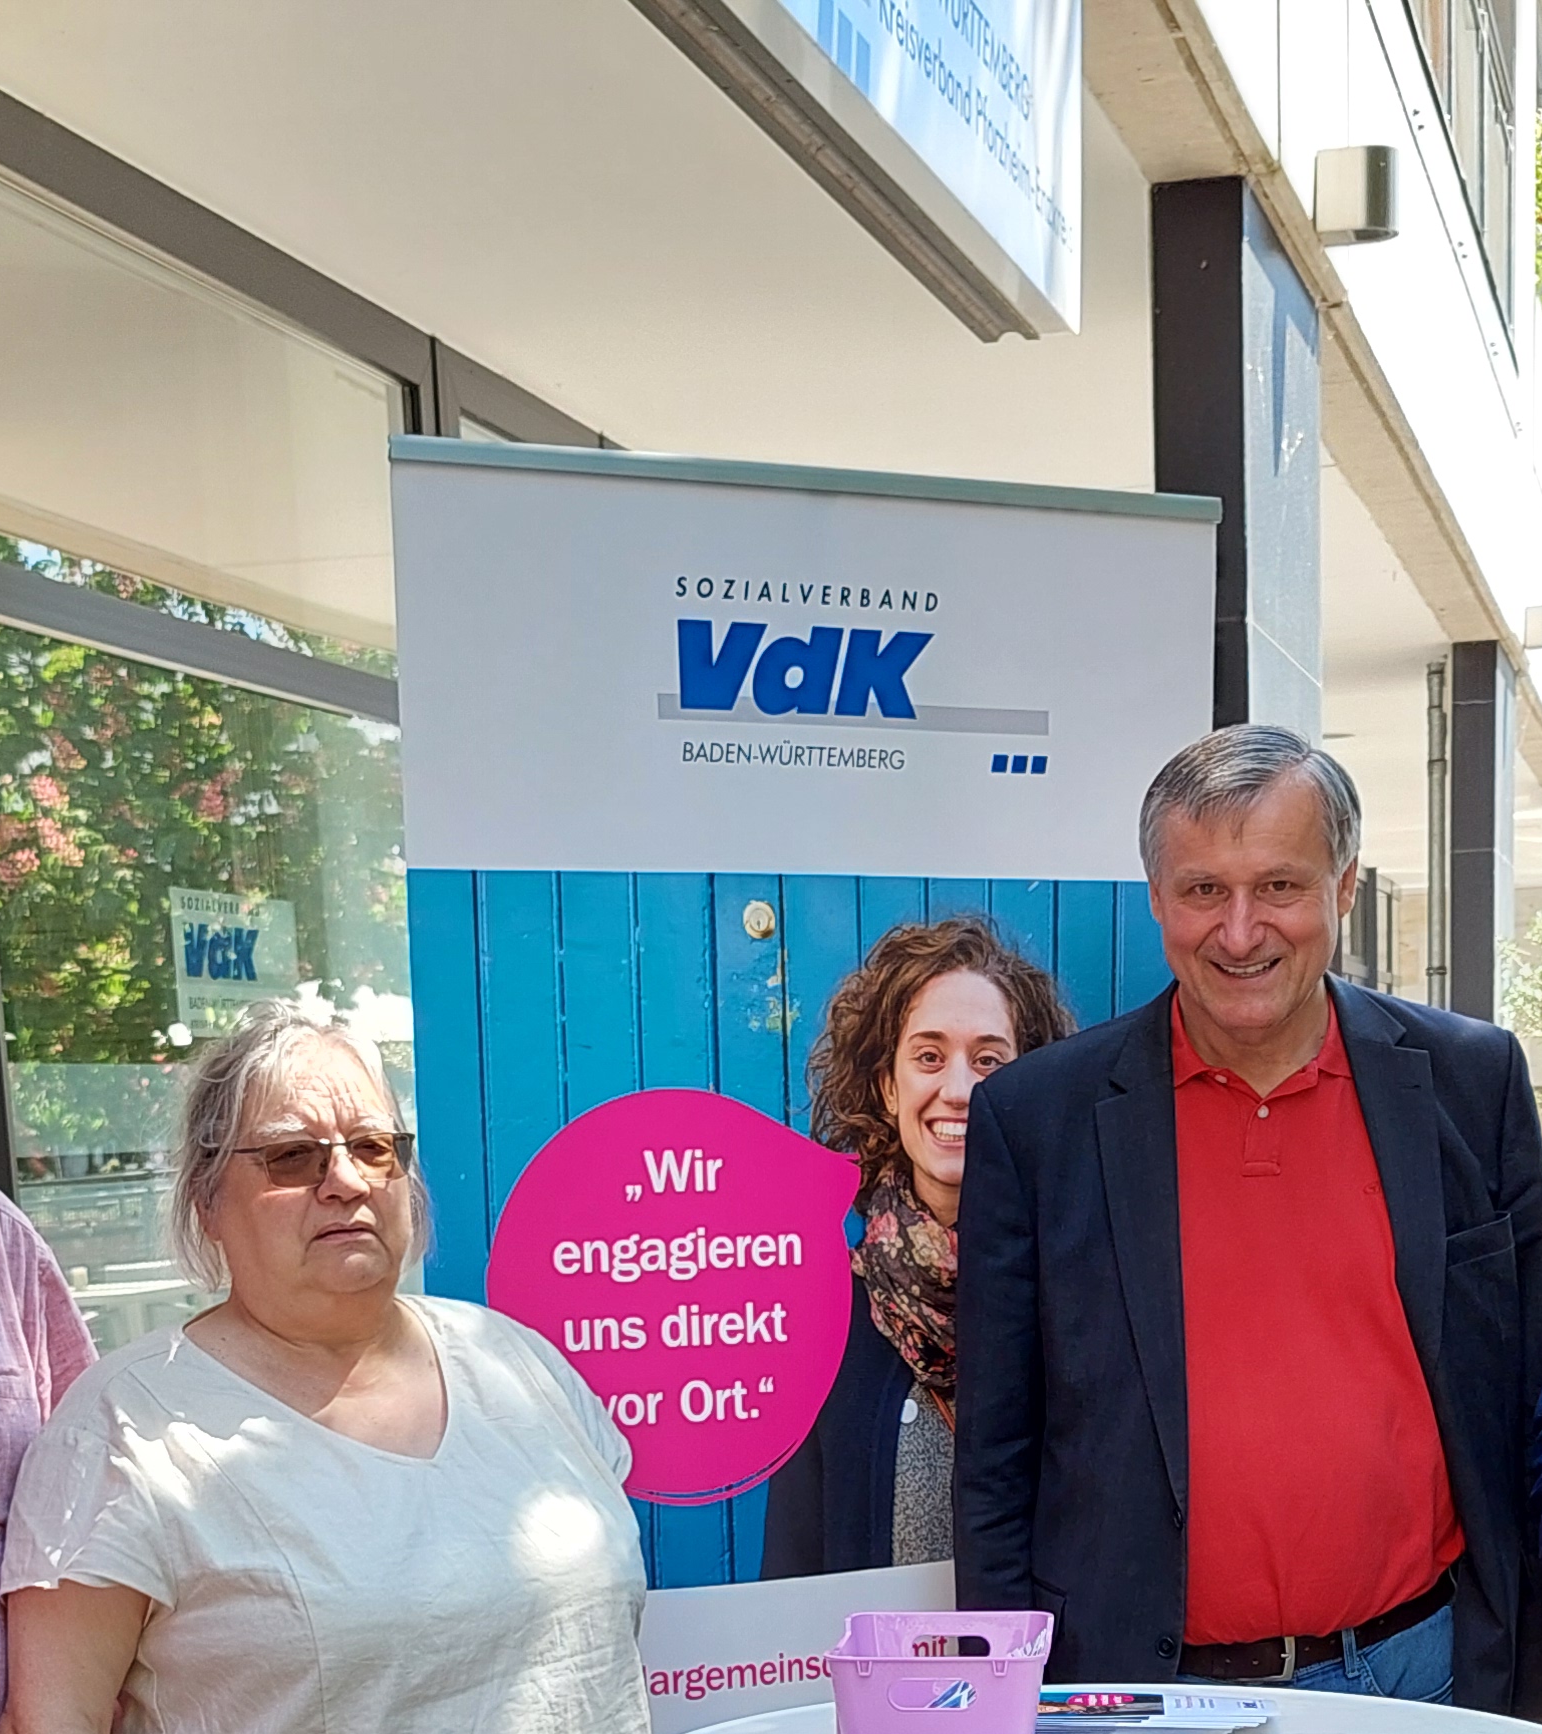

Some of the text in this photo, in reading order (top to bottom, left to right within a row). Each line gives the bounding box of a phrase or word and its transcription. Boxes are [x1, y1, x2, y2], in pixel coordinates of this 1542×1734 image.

[975, 87, 1073, 253] Pforzheim-Enzkre
[675, 575, 939, 613] SOZIALVERBAND
[677, 618, 935, 721] VdK
[681, 740, 906, 771] BADEN-WÜRTTEMBERG
[625, 1148, 723, 1202] „Wir
[553, 1227, 803, 1283] engagieren
[564, 1301, 788, 1353] uns direkt
